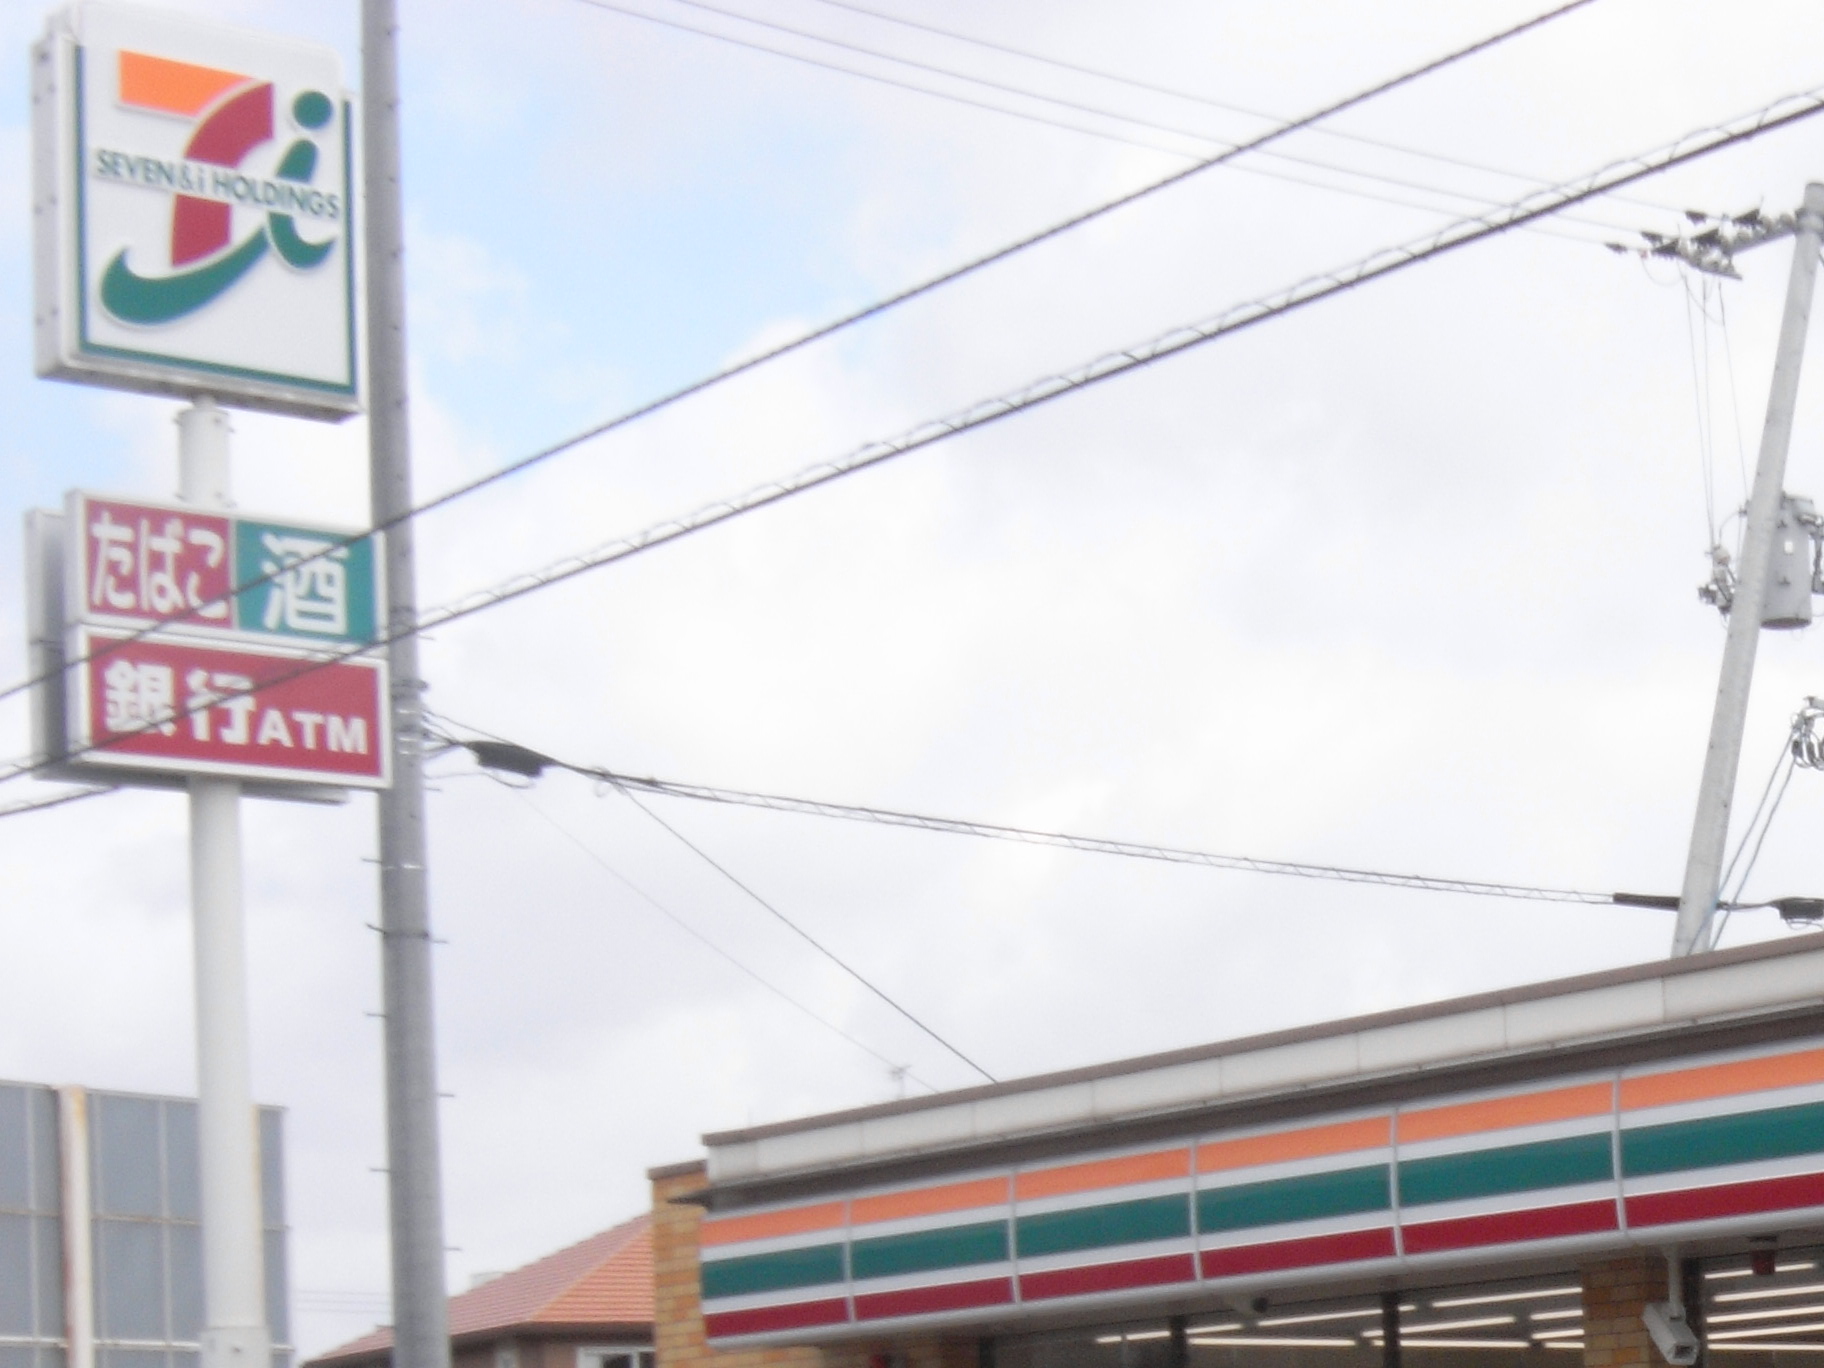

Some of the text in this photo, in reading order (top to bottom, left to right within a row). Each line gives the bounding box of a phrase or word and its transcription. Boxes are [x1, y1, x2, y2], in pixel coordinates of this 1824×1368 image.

[211, 169, 341, 219] HOLDINGS
[90, 511, 349, 636] たばこ 酒
